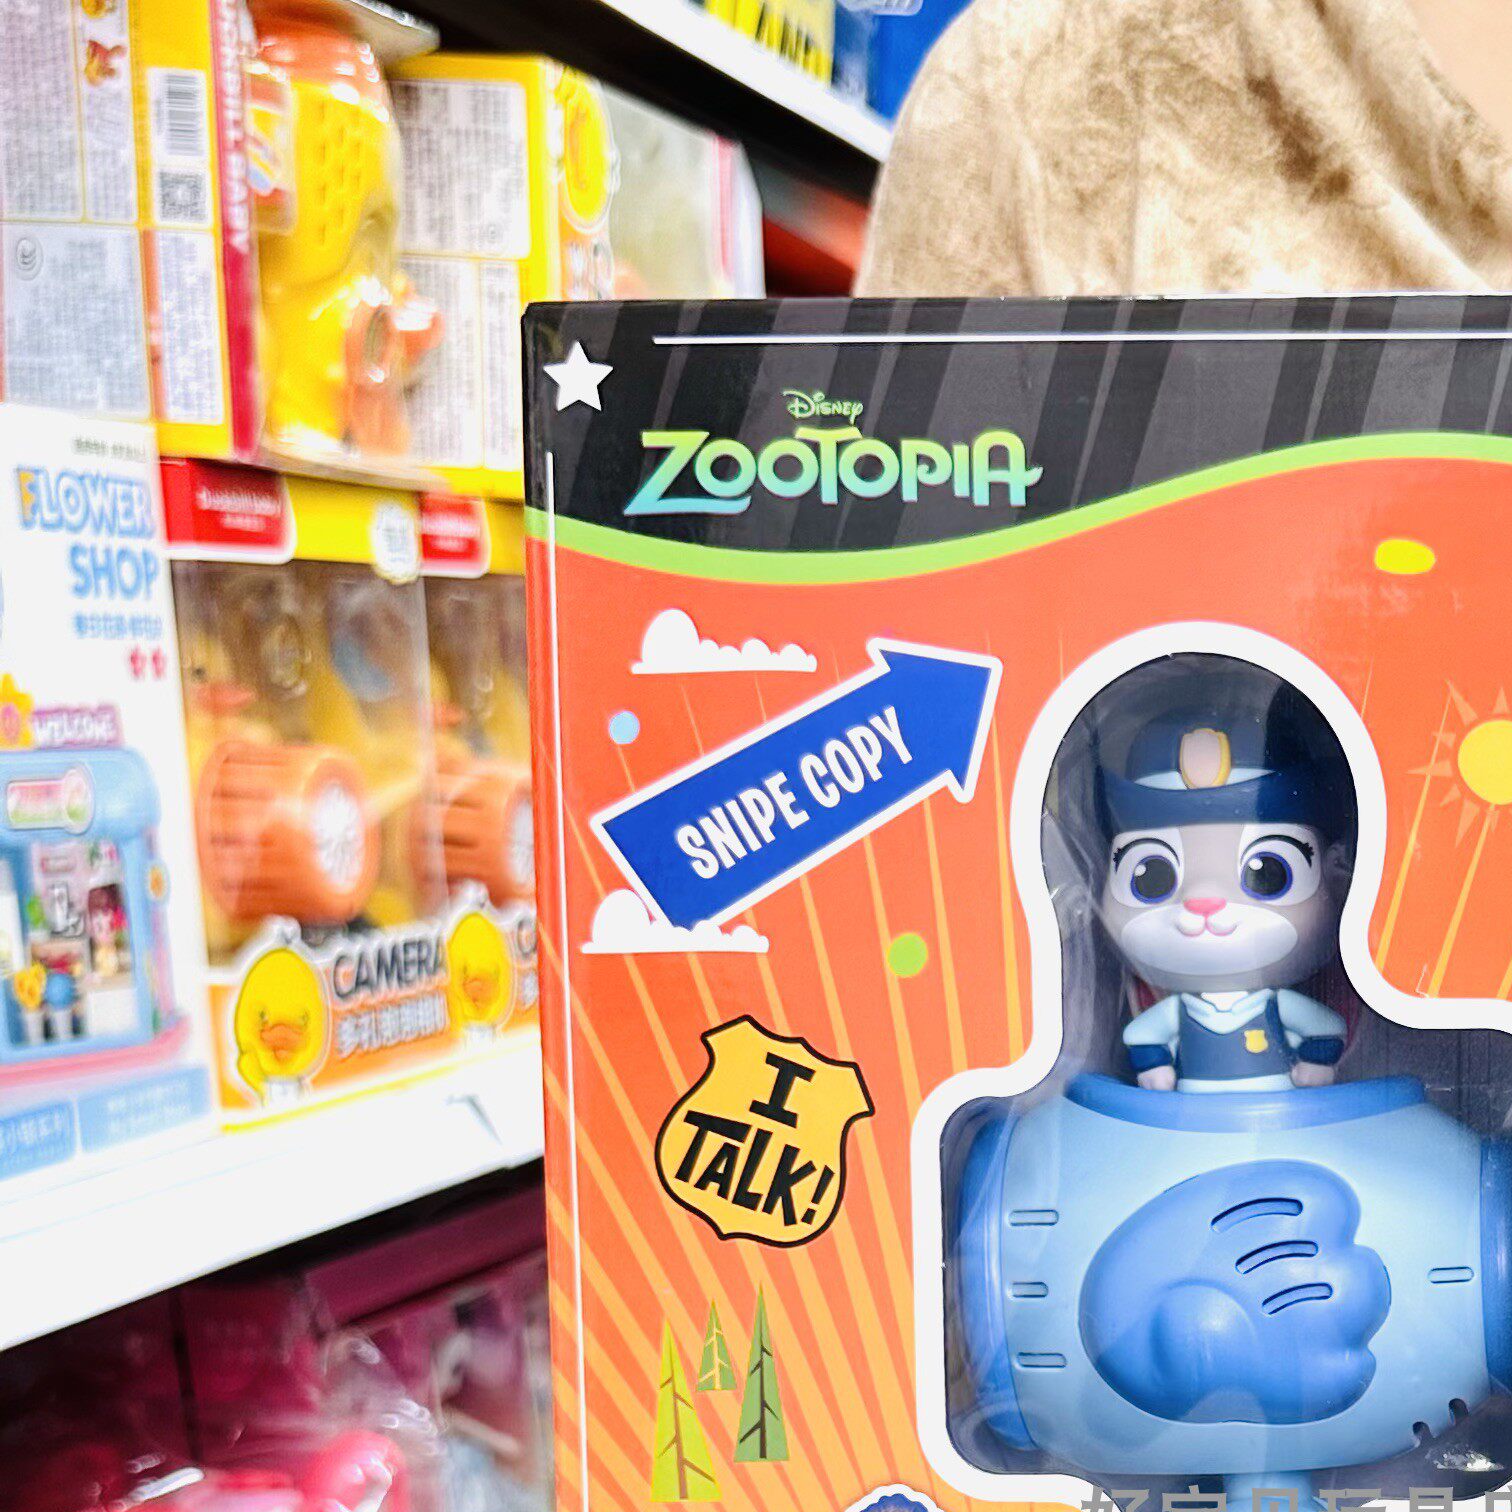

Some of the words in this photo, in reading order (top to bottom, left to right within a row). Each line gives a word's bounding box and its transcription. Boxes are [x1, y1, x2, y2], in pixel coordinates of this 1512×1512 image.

[623, 426, 1043, 516] ZOOTOPIA
[69, 543, 159, 600] SHOP
[676, 771, 810, 879] SNIPE
[800, 706, 912, 808] COPY
[332, 932, 448, 1000] CAMERA
[749, 1052, 816, 1129] I
[675, 1110, 835, 1226] TALK!
